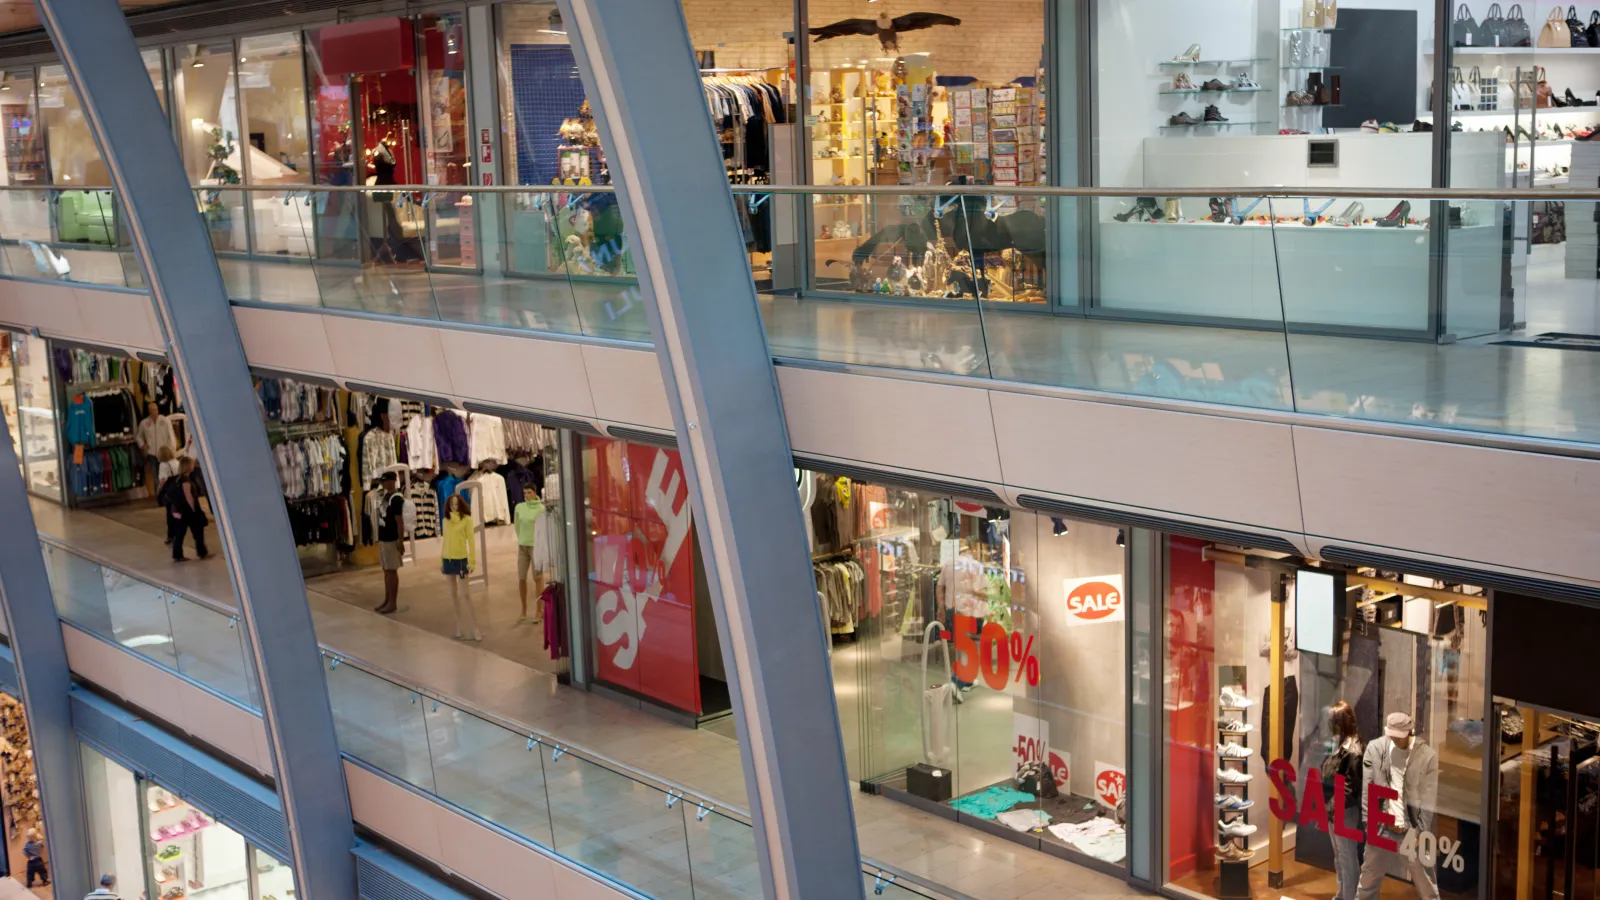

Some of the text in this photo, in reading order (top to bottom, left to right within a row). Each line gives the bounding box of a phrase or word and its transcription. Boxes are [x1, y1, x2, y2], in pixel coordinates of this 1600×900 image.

[1068, 592, 1119, 615] SALE
[940, 613, 1040, 691] -50%
[1098, 778, 1126, 801] SAL
[1269, 758, 1465, 874] SALE 40%
